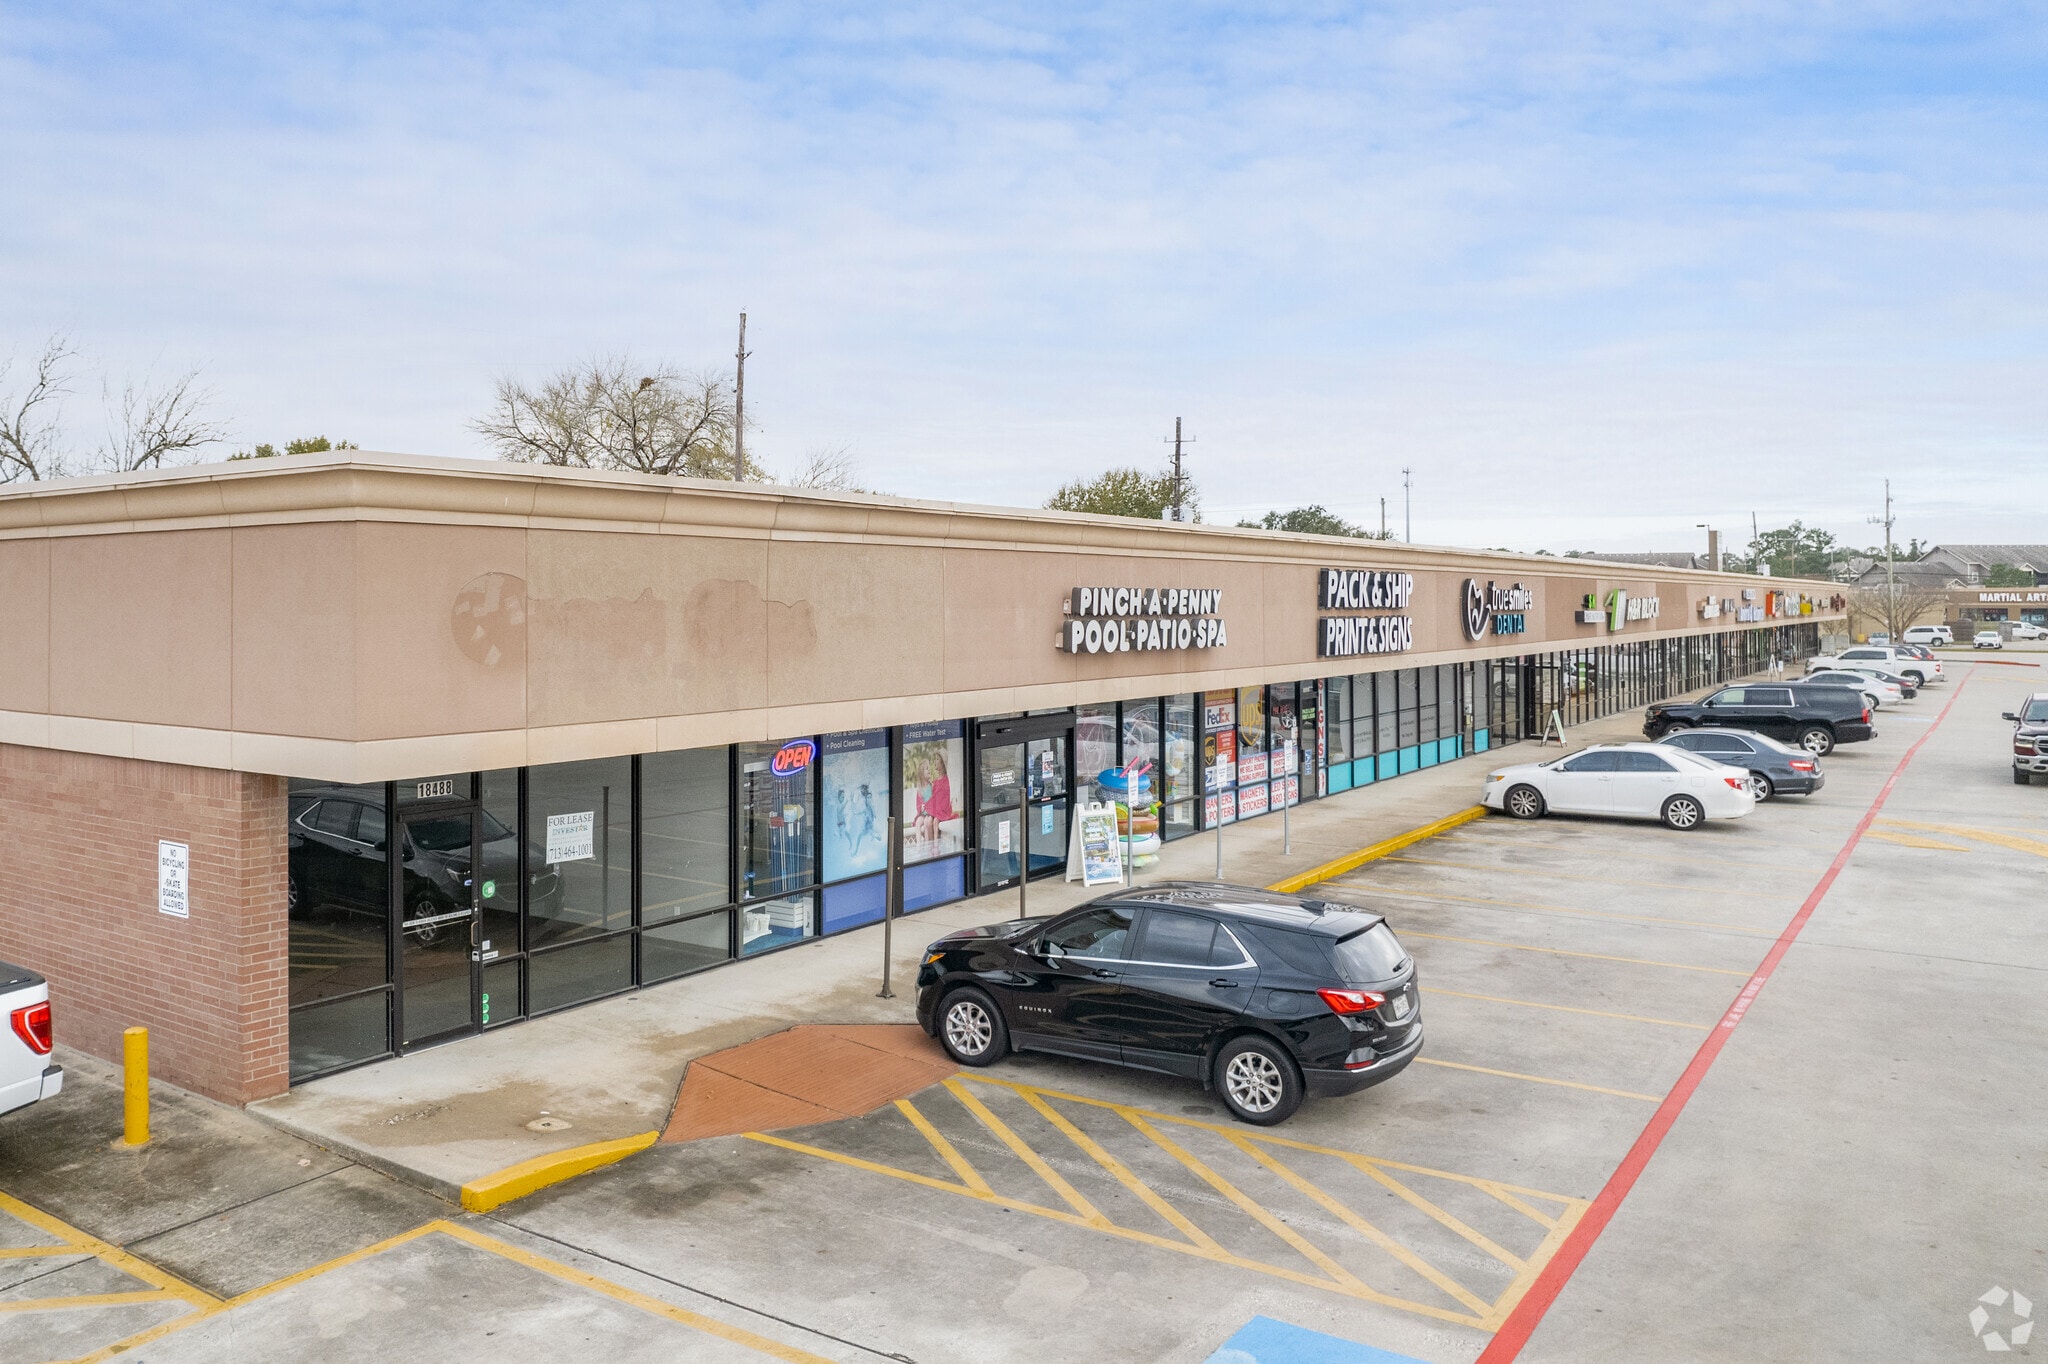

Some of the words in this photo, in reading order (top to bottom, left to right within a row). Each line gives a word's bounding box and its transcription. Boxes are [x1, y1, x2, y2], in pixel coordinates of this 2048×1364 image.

[1327, 570, 1370, 608] PACK
[1371, 572, 1383, 608] &
[1385, 573, 1414, 608] SHIP
[1979, 592, 2022, 602] MARTIAL
[2026, 592, 2048, 602] ART
[1207, 707, 1231, 726] FedEx
[830, 741, 843, 749] Pool
[843, 739, 866, 748] Cleaning
[775, 745, 812, 771] OPEN
[419, 781, 452, 797] 18488
[1240, 786, 1265, 800] MAGNETS
[1206, 793, 1233, 809] BANERS
[1242, 797, 1268, 812] STICKERS
[1209, 805, 1235, 821] POTERS
[548, 816, 566, 827] FOR
[567, 813, 593, 825] LEASE
[170, 849, 177, 858] NO
[162, 857, 185, 869] BICYCLING
[170, 869, 177, 878] OR
[166, 878, 181, 889] SKATE
[163, 887, 185, 900] BOARDING
[163, 899, 184, 911] ALLOWED
[1019, 1005, 1052, 1014] EQUINOX
